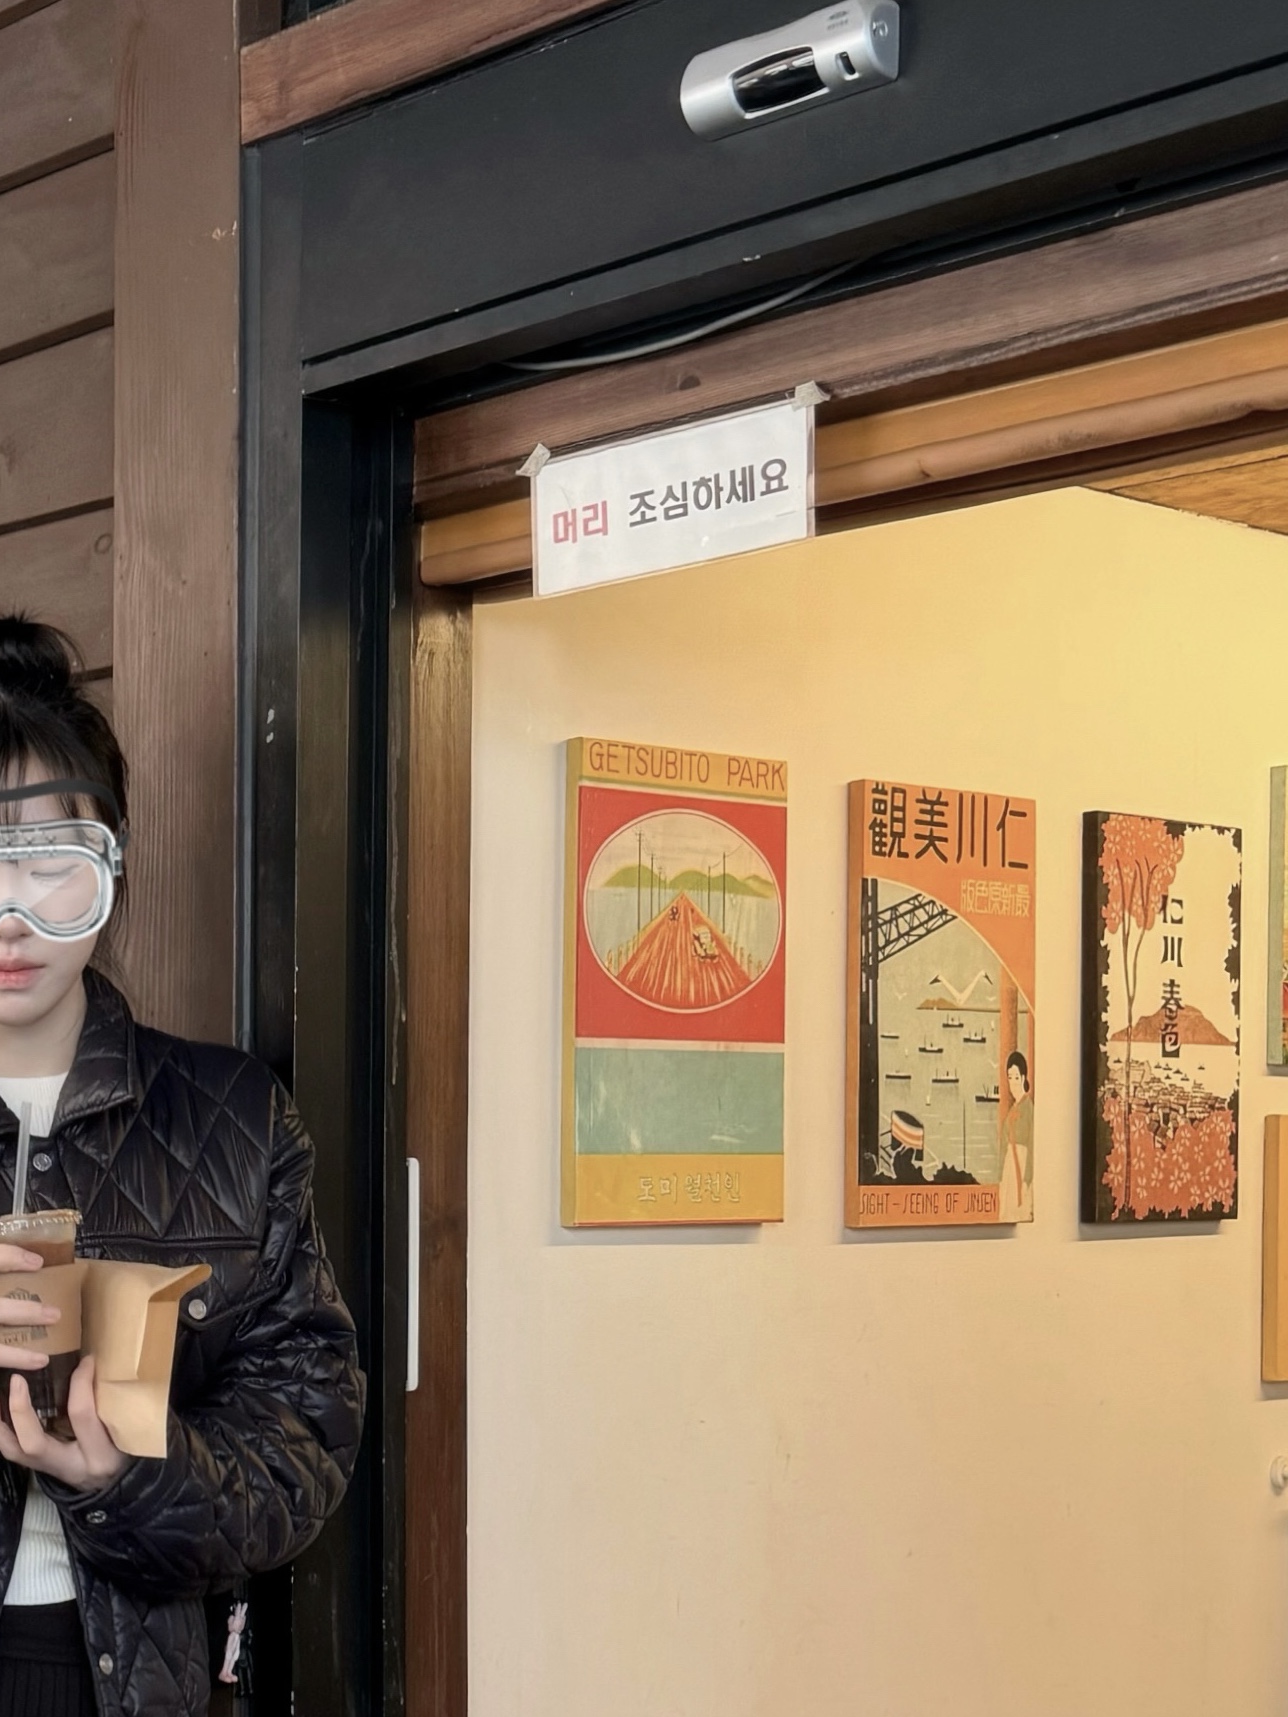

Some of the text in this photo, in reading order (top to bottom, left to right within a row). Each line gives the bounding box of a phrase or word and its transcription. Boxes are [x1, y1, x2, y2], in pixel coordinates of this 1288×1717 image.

[553, 458, 789, 544] 머리 조심하세요
[589, 741, 785, 792] GETSUBITO PARK
[1159, 894, 1185, 1058] 仁川春色
[946, 1192, 960, 1213] OF
[964, 1192, 997, 1214] JINSEN
